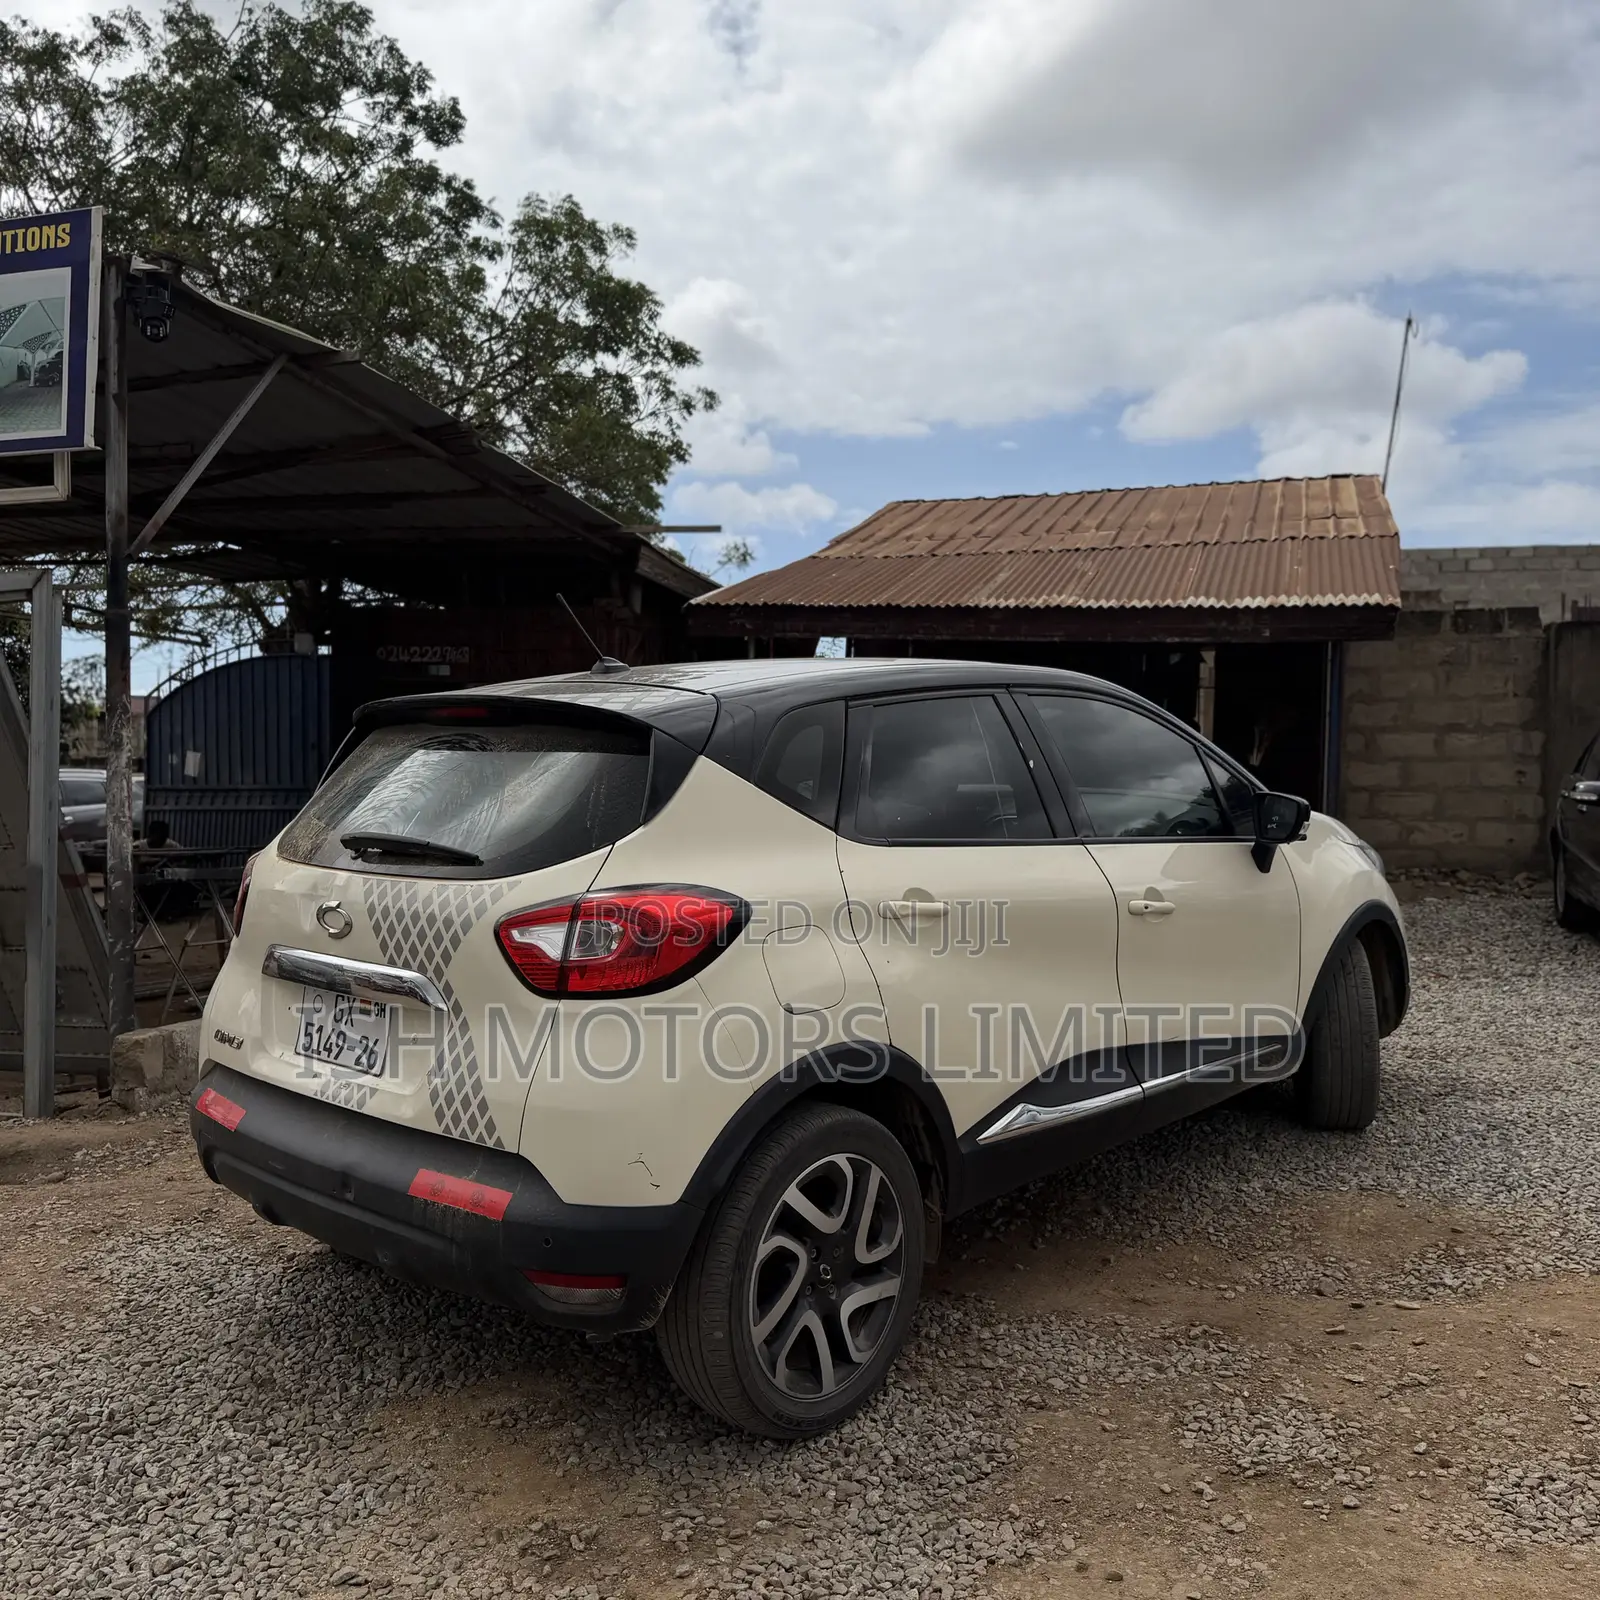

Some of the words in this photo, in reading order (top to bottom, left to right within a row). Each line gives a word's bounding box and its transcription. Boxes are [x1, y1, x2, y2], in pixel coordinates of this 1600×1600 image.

[0, 223, 71, 254] TIONS
[333, 994, 356, 1027] GX
[373, 1001, 386, 1018] GH
[301, 1021, 380, 1070] 5149-26
